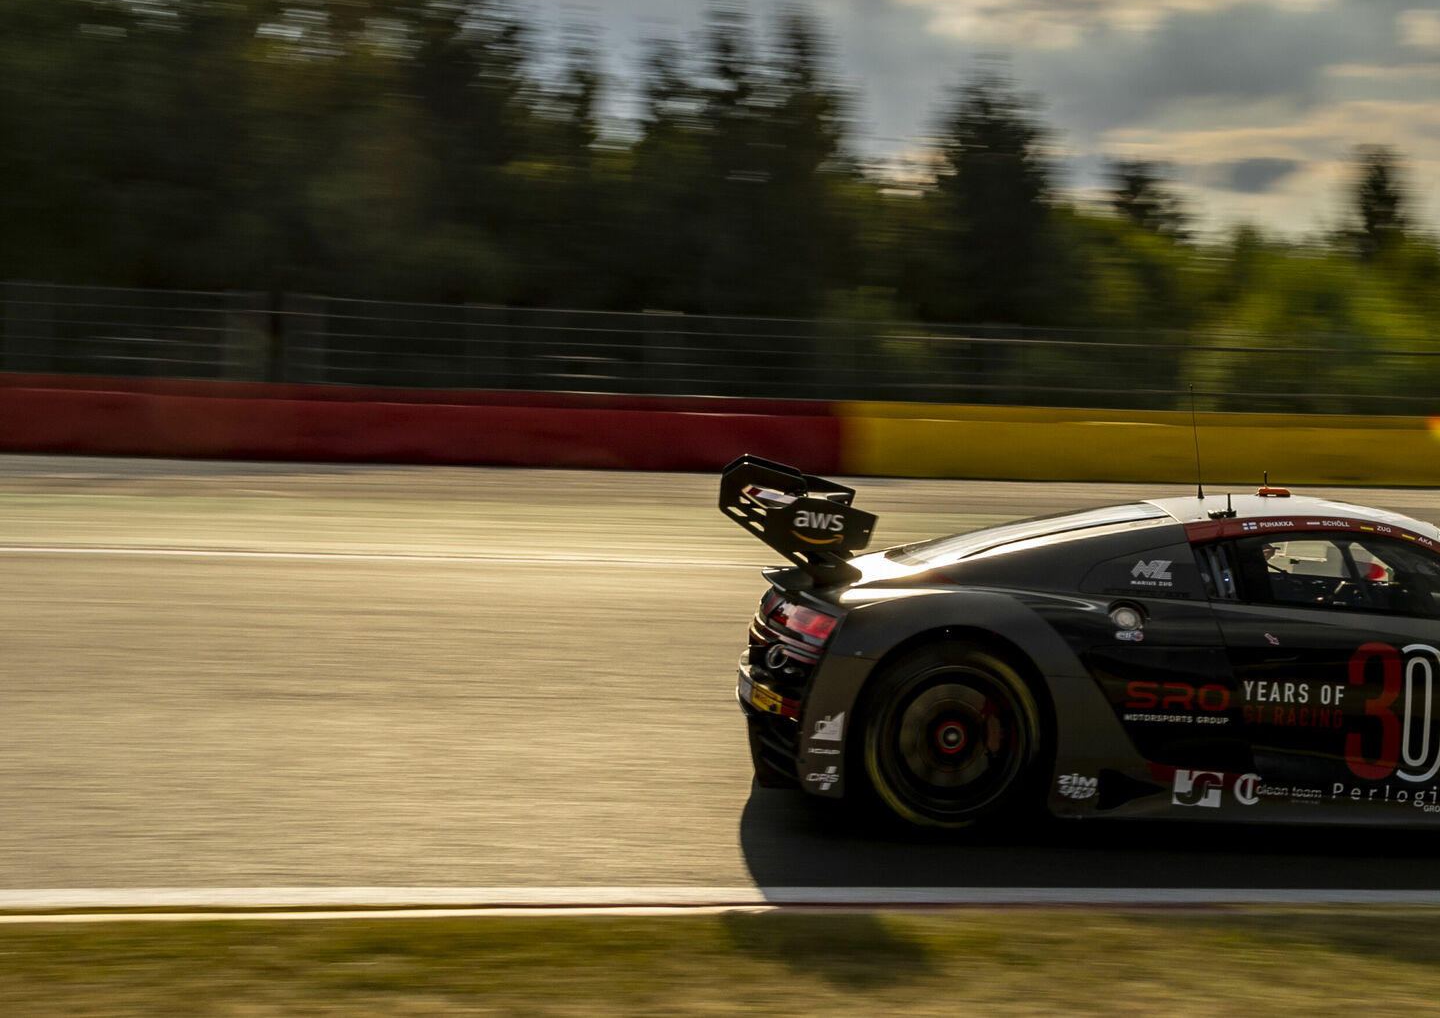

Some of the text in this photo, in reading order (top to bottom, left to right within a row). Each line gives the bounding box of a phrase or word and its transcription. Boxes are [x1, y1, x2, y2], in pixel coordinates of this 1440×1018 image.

[793, 510, 845, 532] aws
[1322, 520, 1350, 528] SCHÖLL
[1376, 525, 1392, 533] ZUG
[1417, 537, 1433, 547] AKA
[1124, 681, 1231, 712] SRO
[1243, 680, 1345, 706] YEARS OF
[1123, 713, 1230, 725] MOTORSPORTS GROUP
[1242, 705, 1345, 730] GT RACING
[1256, 783, 1289, 796] clean
